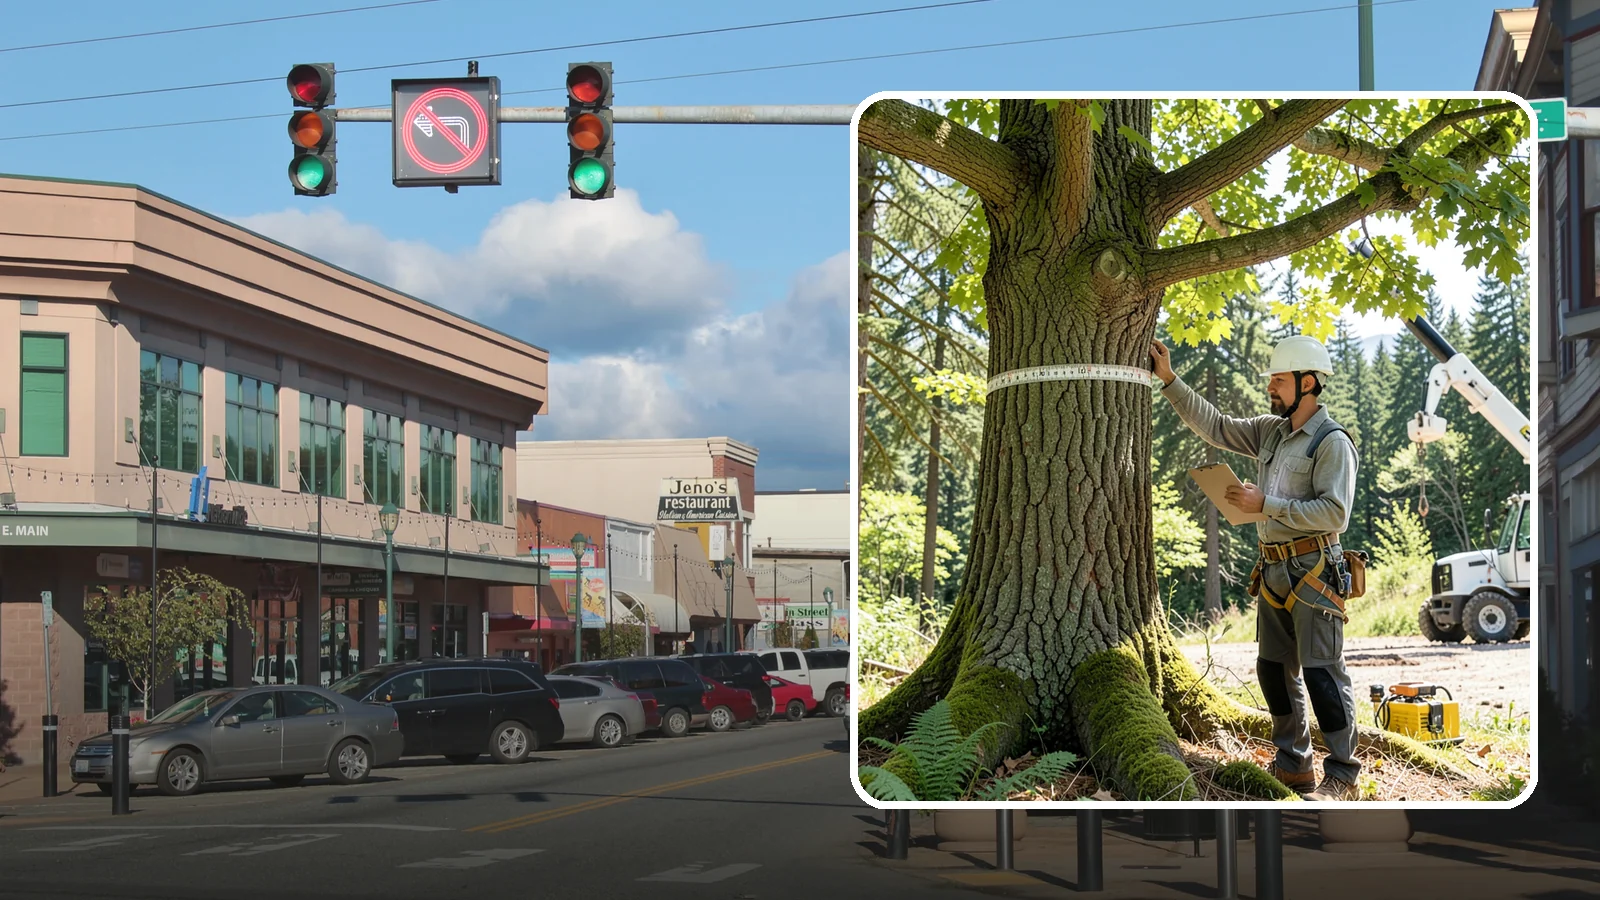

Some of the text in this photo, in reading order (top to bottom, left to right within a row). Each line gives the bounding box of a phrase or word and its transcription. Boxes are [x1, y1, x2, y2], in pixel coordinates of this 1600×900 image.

[669, 480, 727, 494] Jeno's
[665, 496, 730, 508] restaurant
[658, 510, 681, 519] Italian
[686, 510, 714, 519] American
[714, 509, 737, 519] Cuisine
[2, 525, 49, 536] E. MAIN
[798, 607, 828, 616] Street
